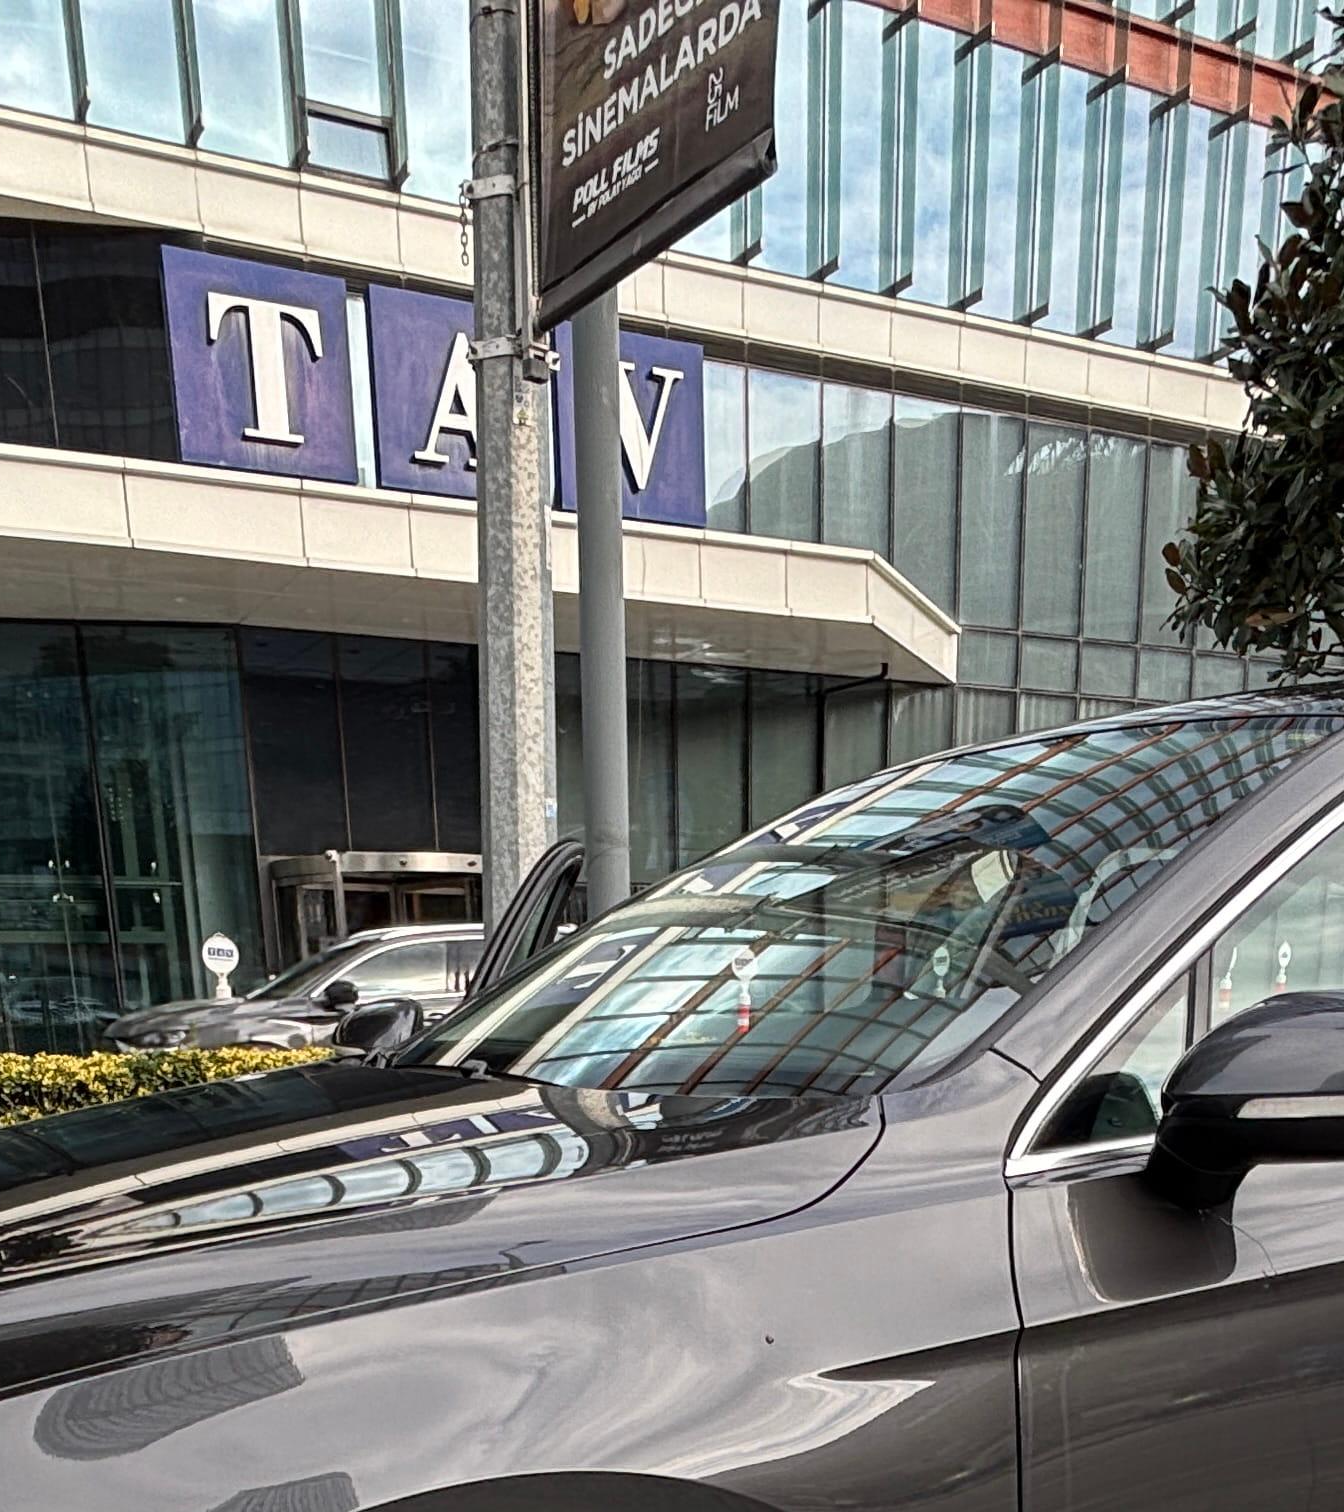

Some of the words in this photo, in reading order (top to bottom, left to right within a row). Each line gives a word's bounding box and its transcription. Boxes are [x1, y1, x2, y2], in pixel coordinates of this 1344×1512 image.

[561, 0, 762, 167] SİNEMALARDA
[705, 85, 739, 132] FILM
[572, 168, 609, 213] POLL
[612, 127, 660, 184] FILMS
